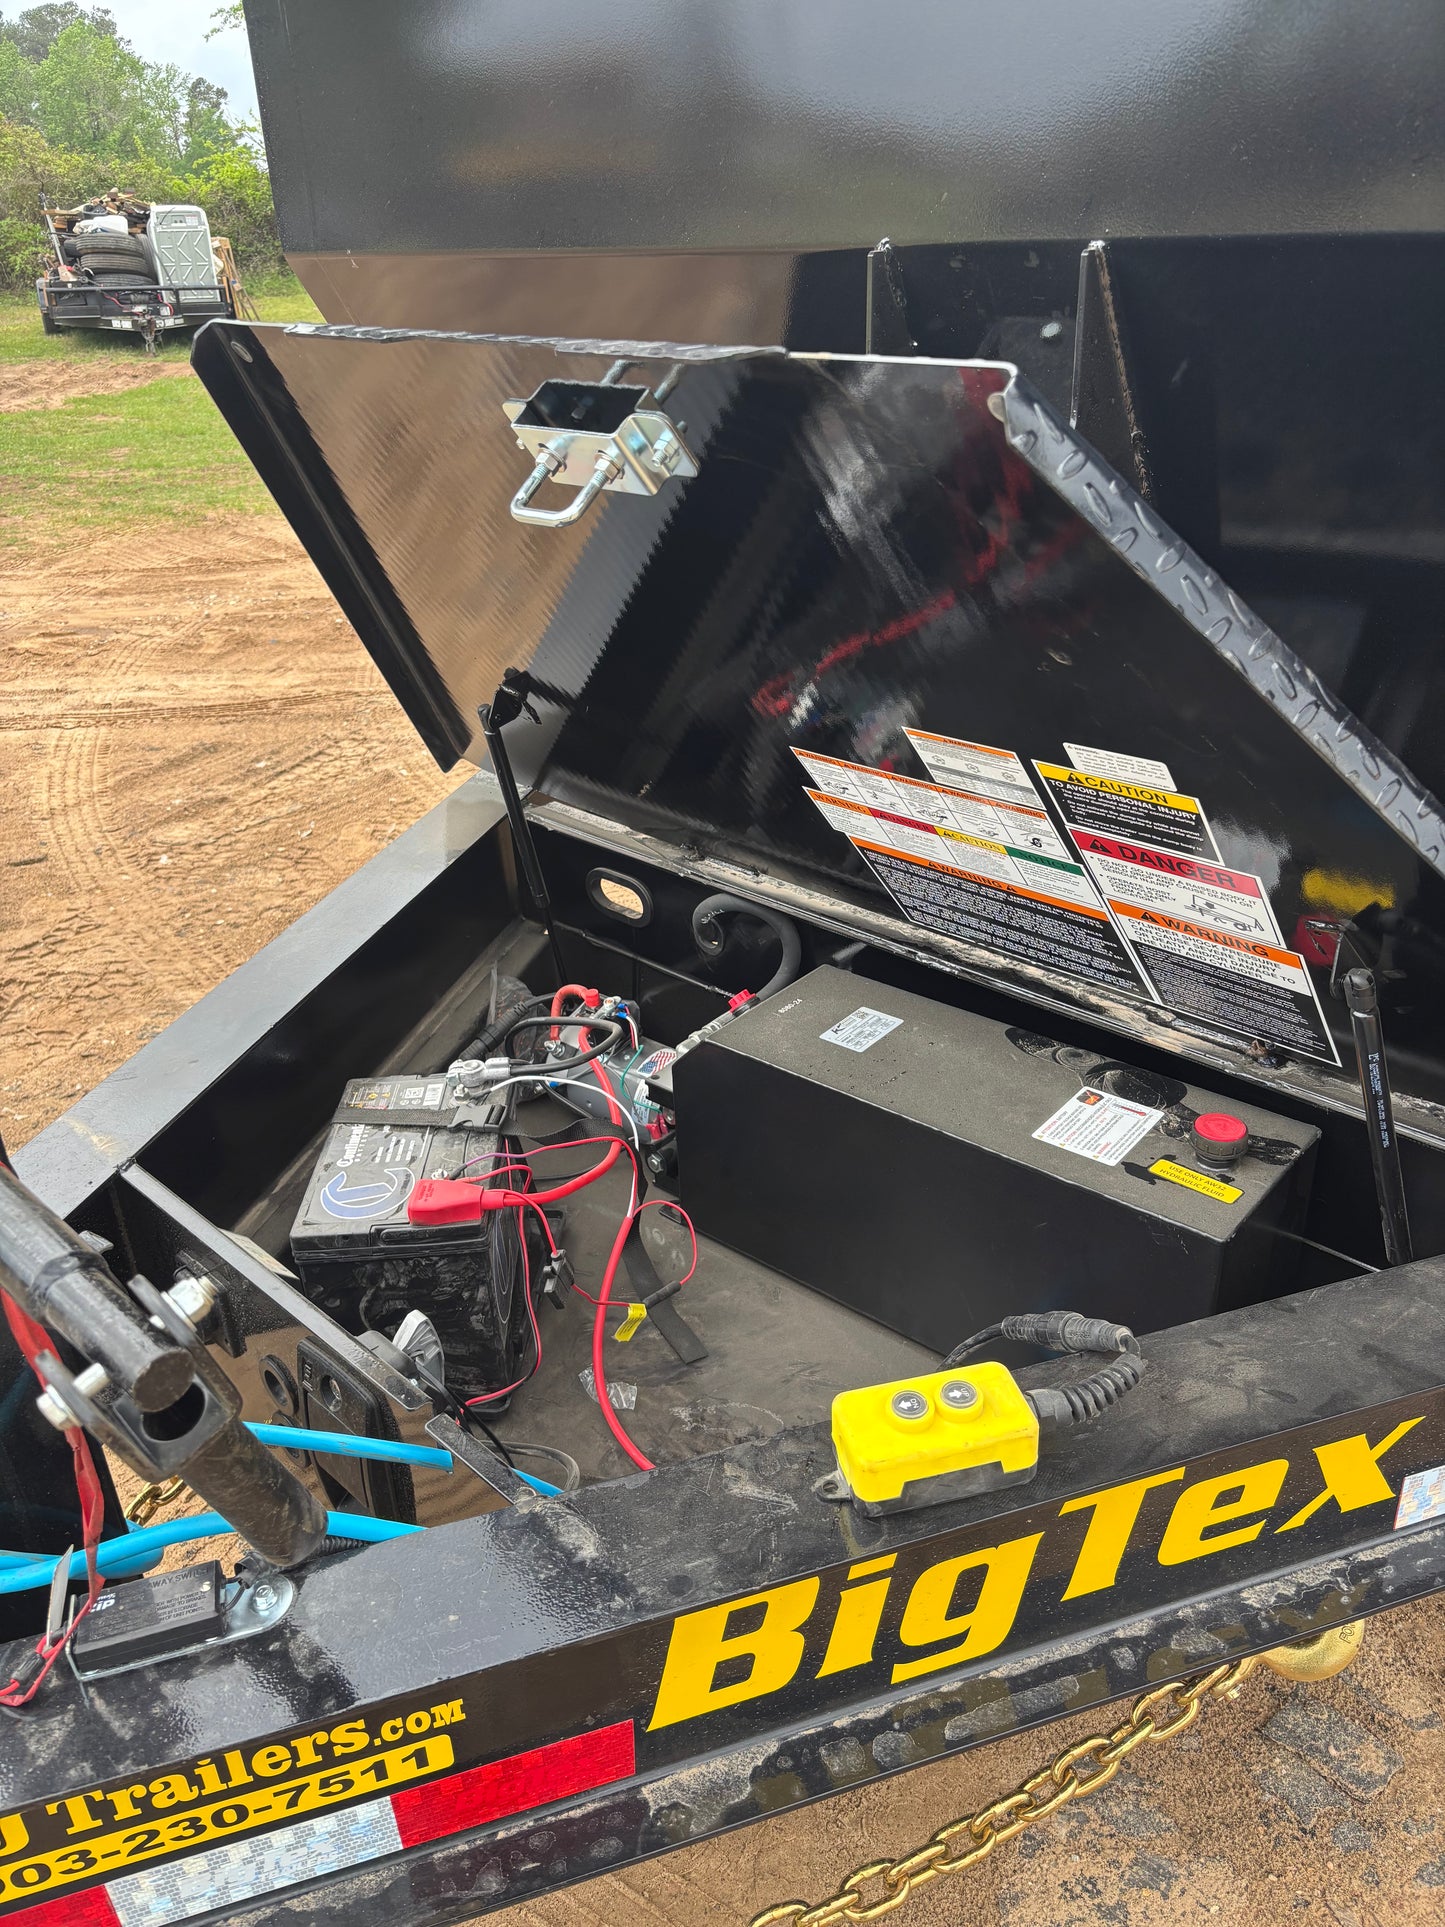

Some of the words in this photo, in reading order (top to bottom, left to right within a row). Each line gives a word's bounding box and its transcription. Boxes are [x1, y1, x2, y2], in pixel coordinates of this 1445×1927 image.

[1049, 779, 1063, 787] TO
[1064, 783, 1097, 796] AVOID
[1097, 791, 1155, 810] PERSONAL
[1156, 805, 1197, 820] INJURY
[1083, 775, 1168, 804] CAUTION
[944, 829, 1001, 852] CAUTION
[1017, 850, 1070, 871] NOTICE
[1116, 844, 1237, 889] DANGER
[936, 863, 1003, 888] WARNING
[1126, 917, 1179, 938] CYLINDER
[1181, 934, 1219, 950] SHOCK
[1221, 946, 1281, 969] PRESSURE
[1130, 923, 1153, 934] CAN
[1154, 931, 1191, 946] CAUSE
[1192, 942, 1235, 960] SEVERE
[1236, 956, 1277, 973] INJURY
[1136, 935, 1157, 946] THE
[1158, 942, 1183, 954] UNIT
[1184, 950, 1207, 962] AND
[1161, 916, 1269, 957] WARNING
[1133, 929, 1149, 938] OR
[1150, 935, 1186, 950] DEATH
[1187, 946, 1228, 963] AND/OR
[1229, 959, 1278, 979] DAMAGE
[1280, 975, 1295, 984] TO
[1158, 1168, 1203, 1188] HYDRAULIC
[1201, 1185, 1225, 1197] FLUID
[1168, 1165, 1184, 1174] USE
[1183, 1171, 1205, 1182] ONLY
[960, 1387, 970, 1398] UP
[0, 1746, 430, 1895] 03-230-7511
